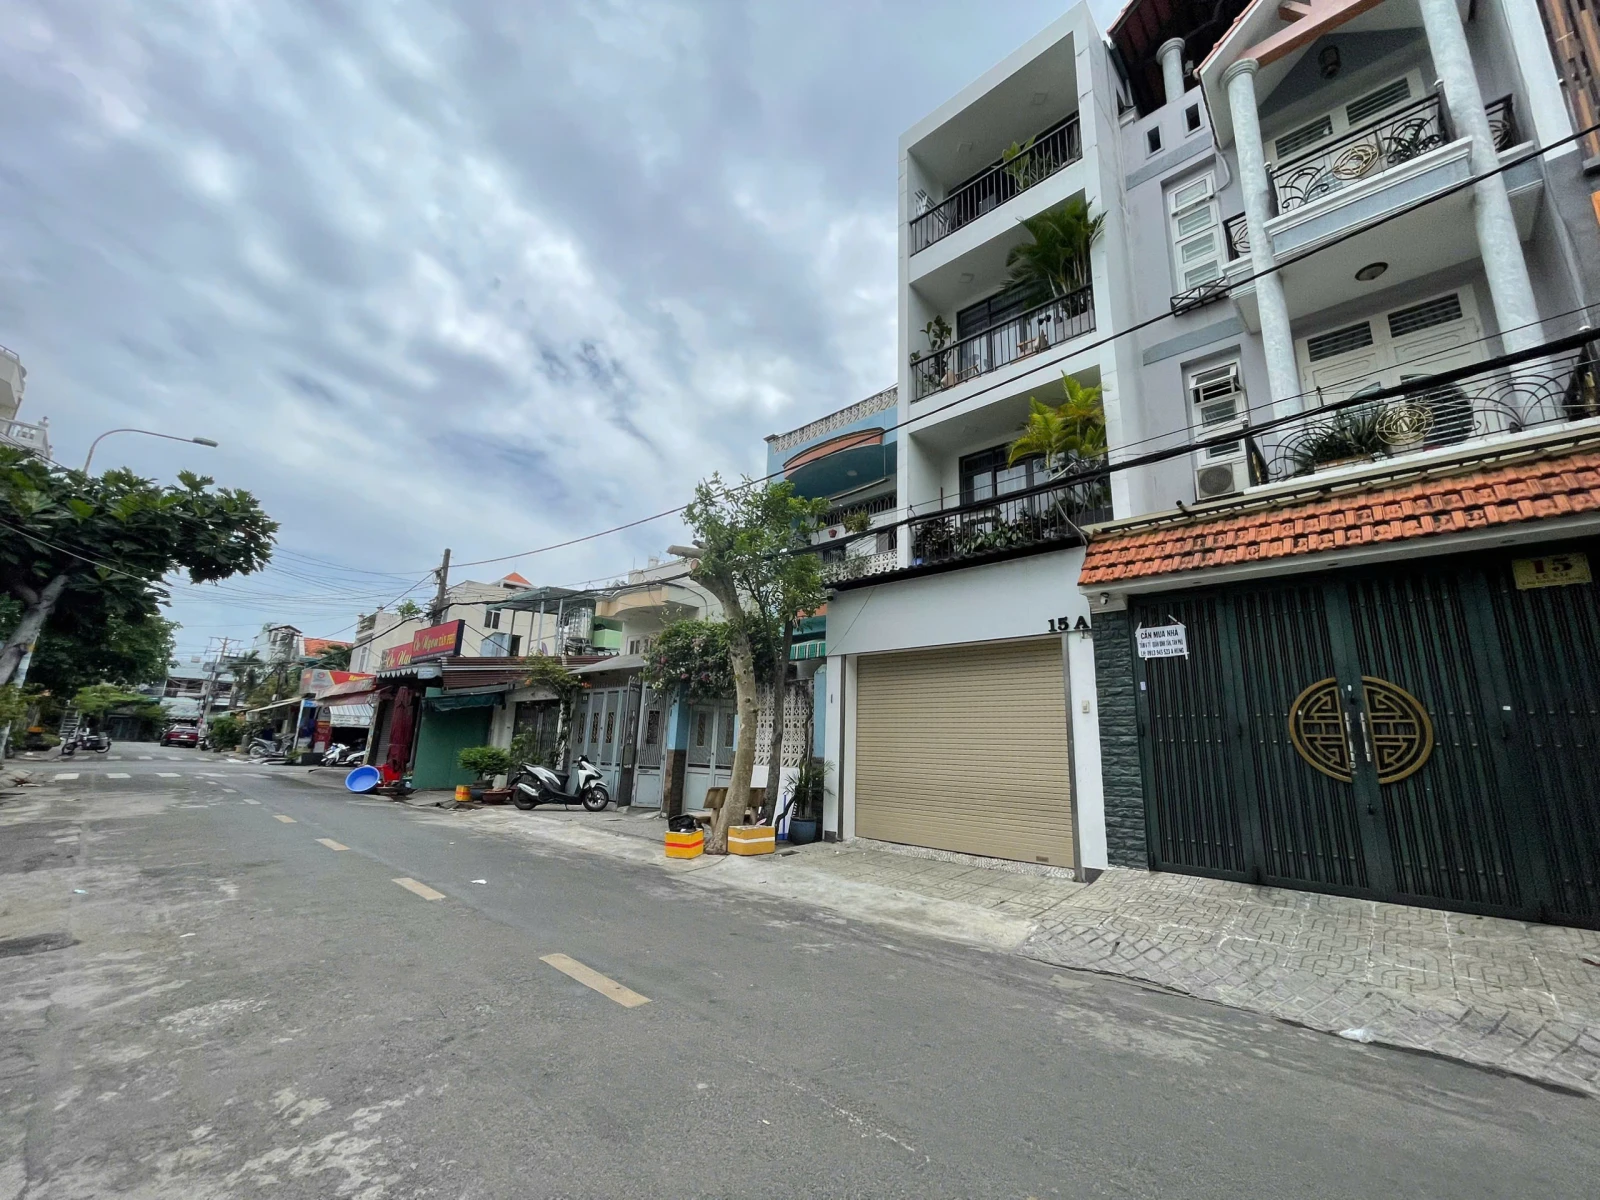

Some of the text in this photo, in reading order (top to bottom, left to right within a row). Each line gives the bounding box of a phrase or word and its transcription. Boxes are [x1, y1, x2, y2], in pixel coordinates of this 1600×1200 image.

[1532, 557, 1573, 574] 15
[1048, 615, 1090, 632] 15 A
[1153, 630, 1165, 638] MUA
